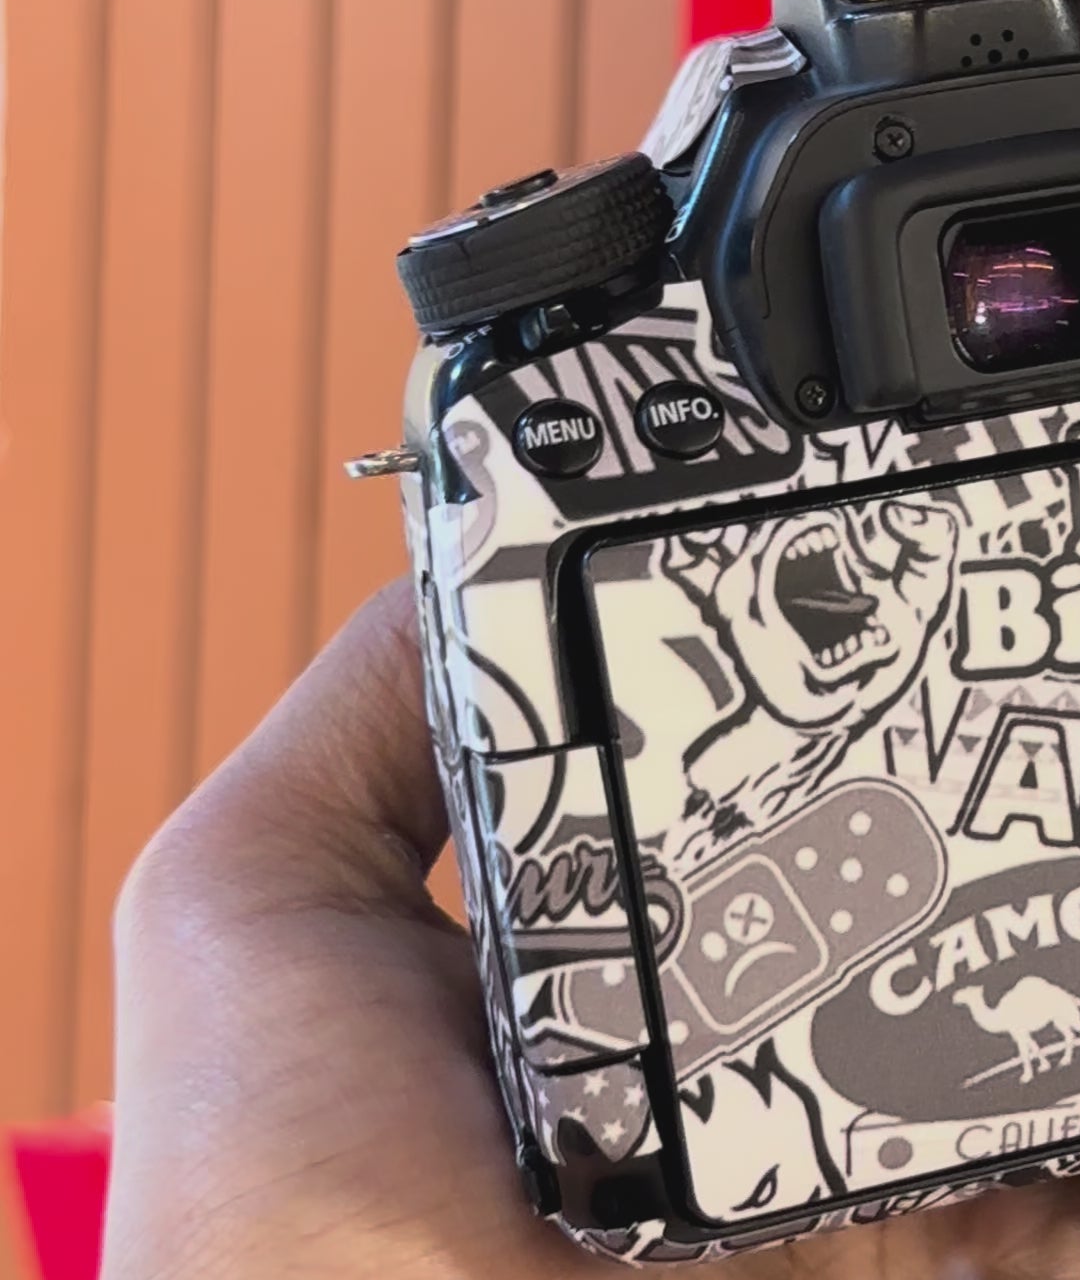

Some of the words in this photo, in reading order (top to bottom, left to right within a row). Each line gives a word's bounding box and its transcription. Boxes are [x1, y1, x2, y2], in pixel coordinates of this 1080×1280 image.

[446, 324, 492, 359] OFF
[649, 397, 720, 429] INFO.
[524, 417, 594, 450] MENU
